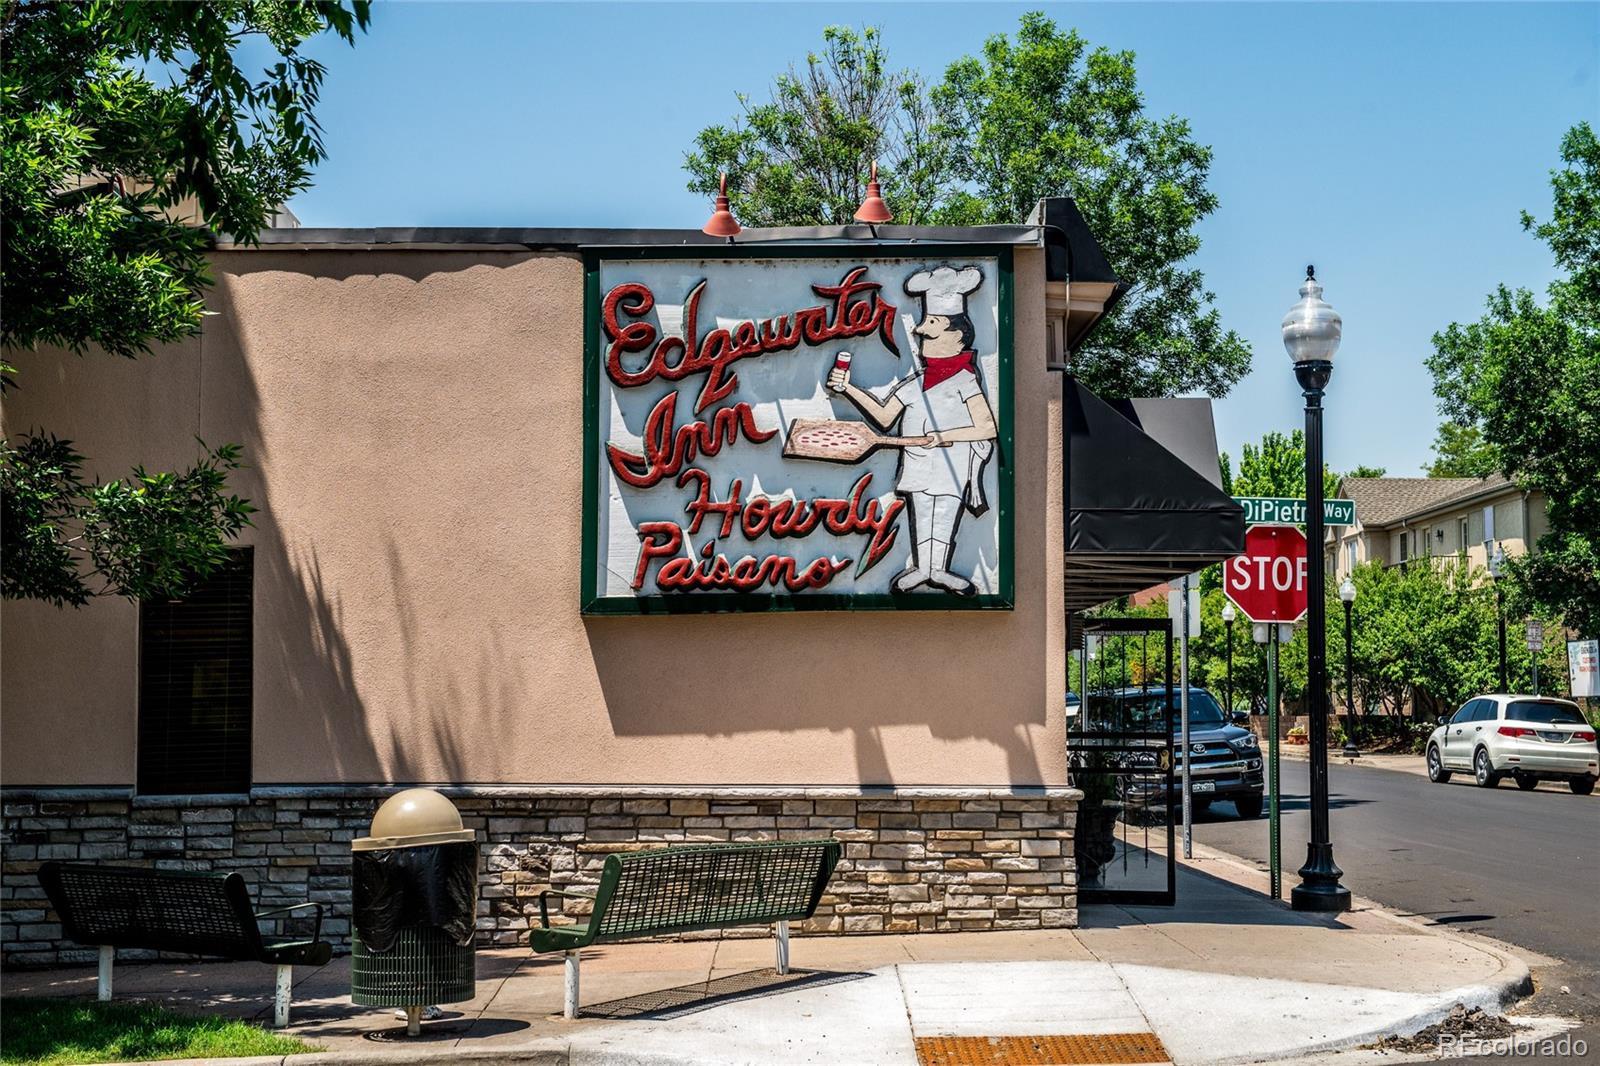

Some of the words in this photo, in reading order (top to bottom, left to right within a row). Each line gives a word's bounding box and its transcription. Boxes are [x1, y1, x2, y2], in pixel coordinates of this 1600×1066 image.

[602, 266, 900, 415] Edgewater
[607, 391, 779, 488] Inn
[630, 521, 852, 591] Paisano
[677, 468, 905, 580] Howdy
[1241, 500, 1307, 522] DiPietr
[1323, 503, 1351, 521] Way
